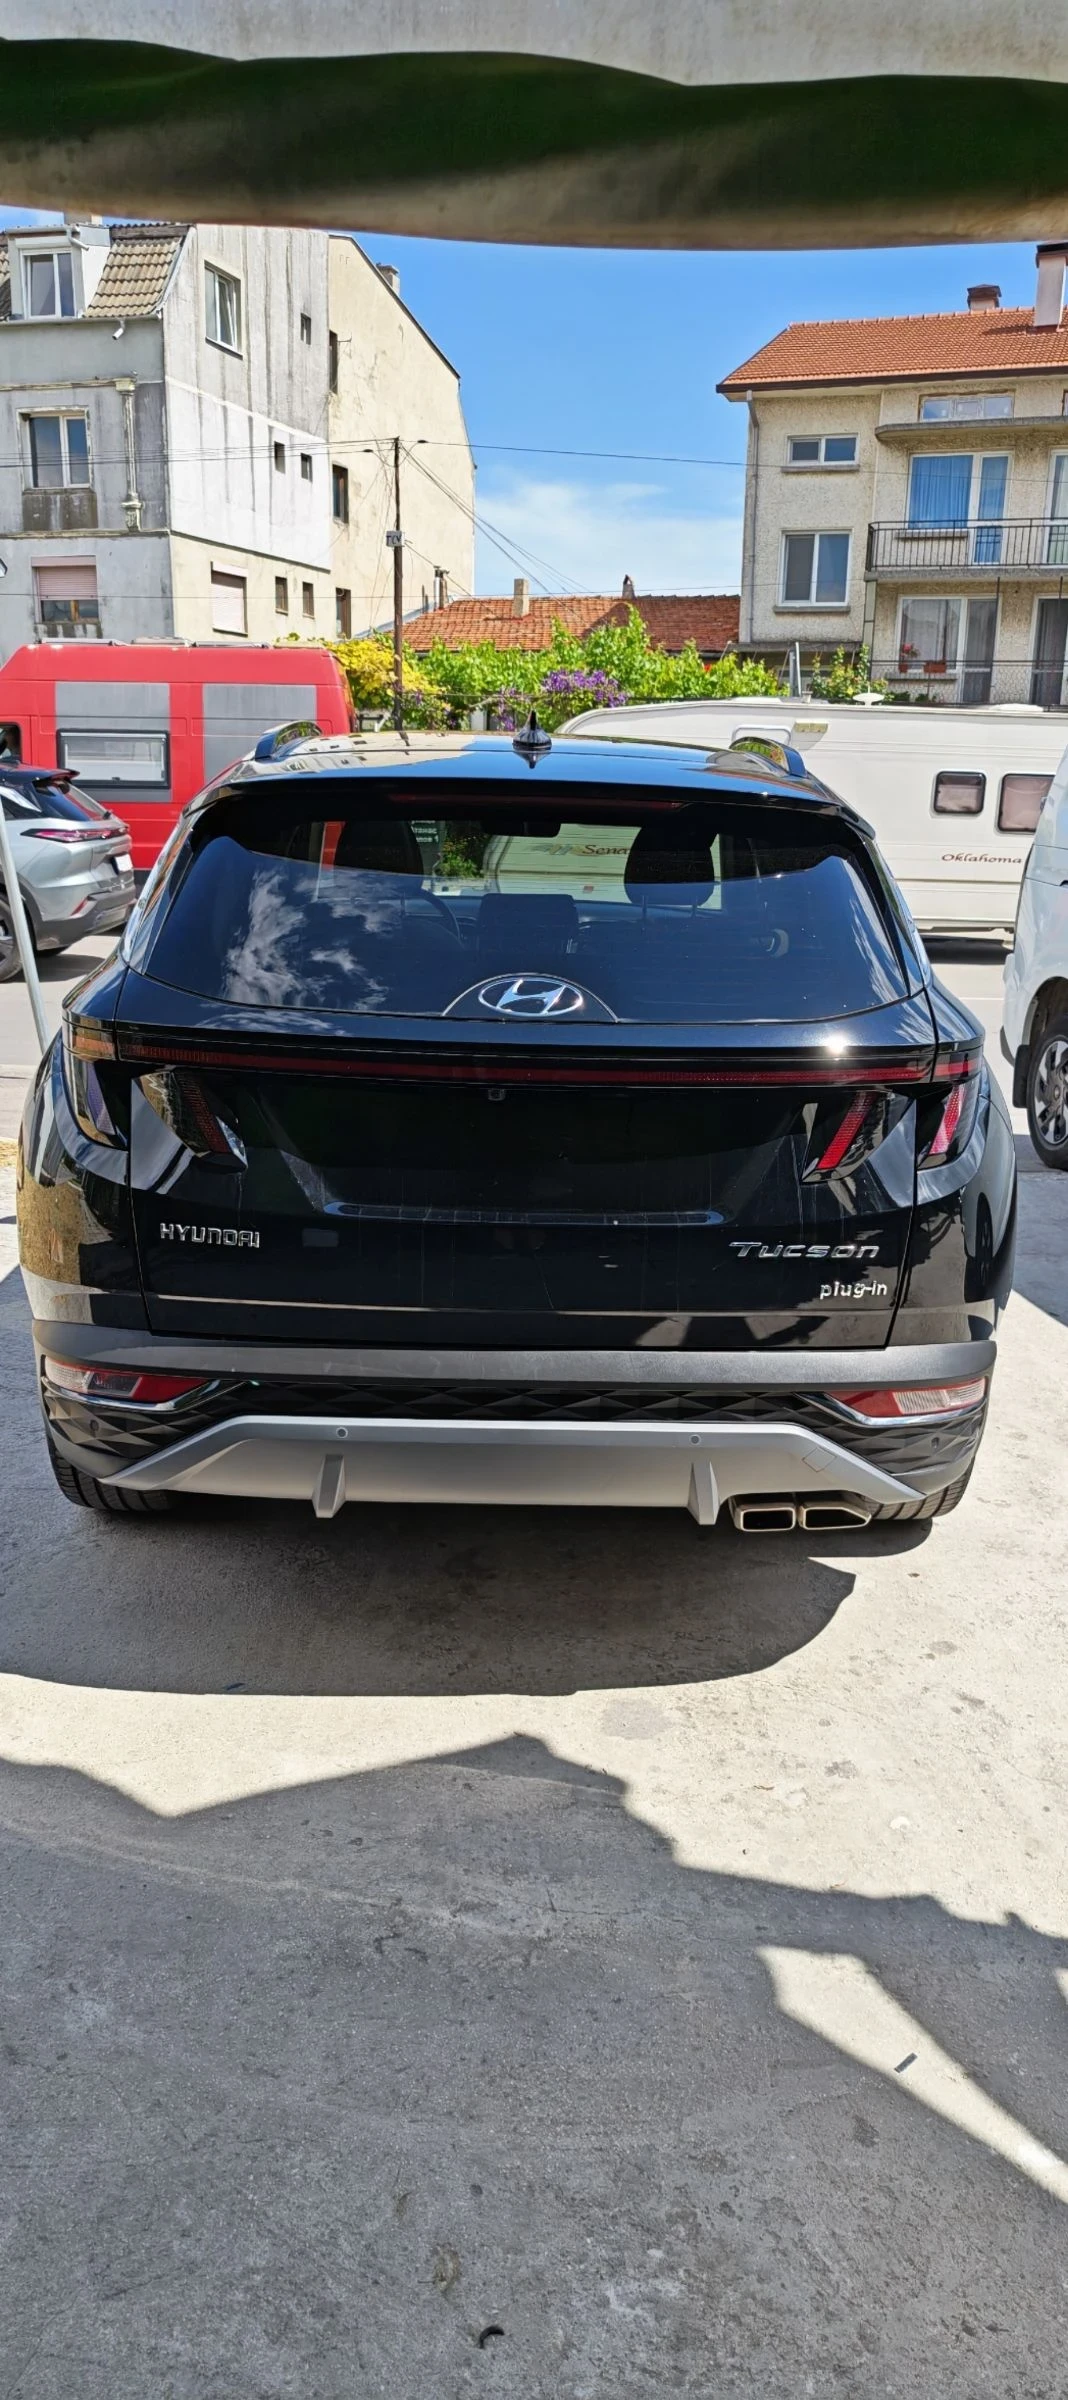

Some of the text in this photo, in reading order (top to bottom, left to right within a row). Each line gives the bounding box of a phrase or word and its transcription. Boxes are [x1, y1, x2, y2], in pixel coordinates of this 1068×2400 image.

[582, 844, 631, 855] Sena
[941, 853, 1022, 863] Oklahoma
[160, 1222, 260, 1248] HYUNDAI
[729, 1241, 880, 1258] Tucson
[819, 1280, 888, 1300] plug-in
